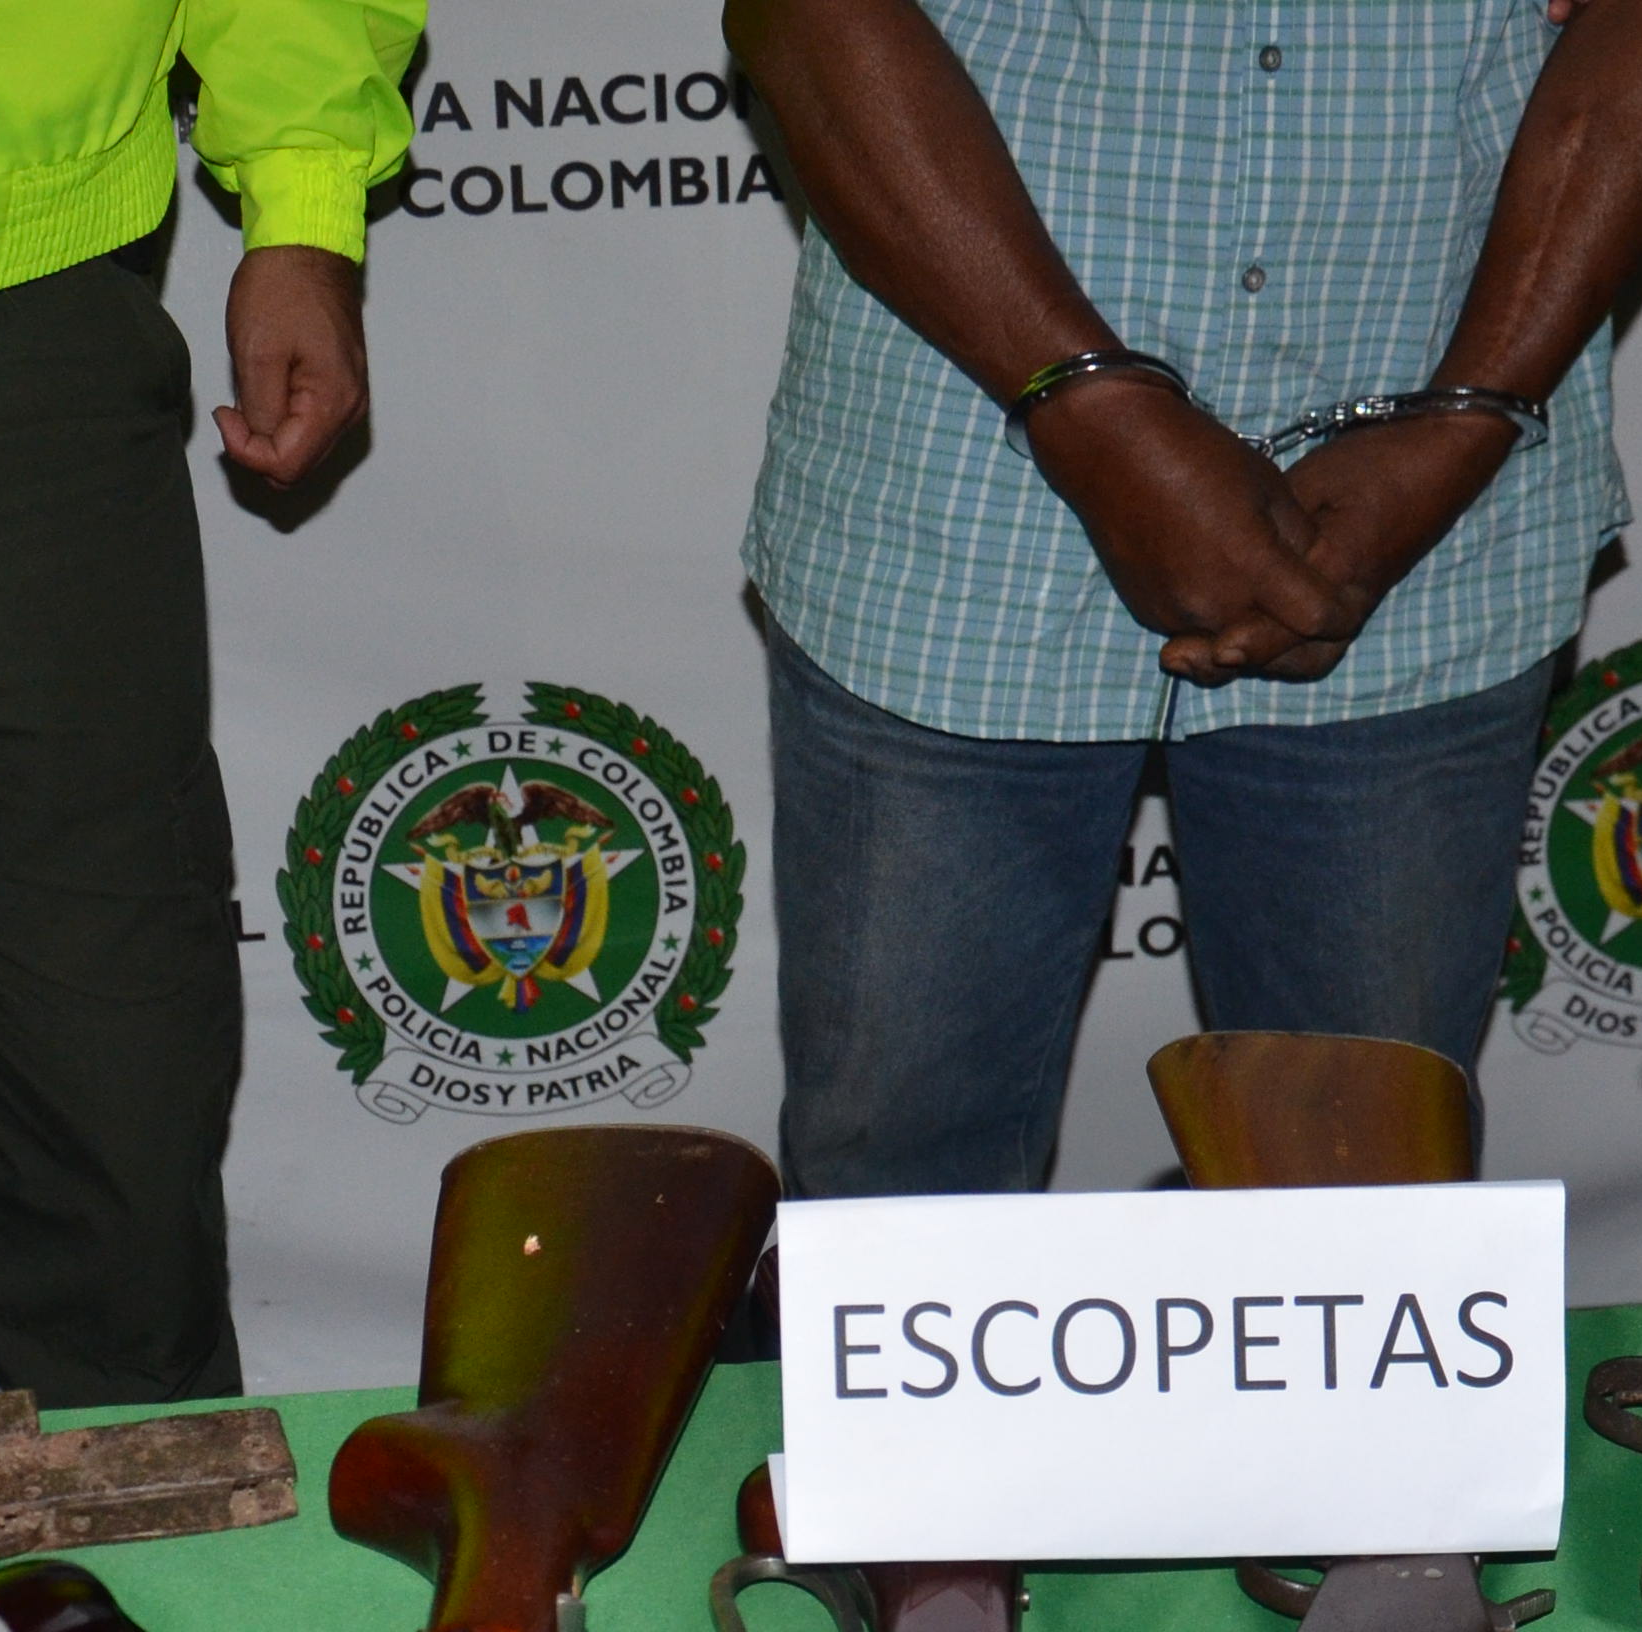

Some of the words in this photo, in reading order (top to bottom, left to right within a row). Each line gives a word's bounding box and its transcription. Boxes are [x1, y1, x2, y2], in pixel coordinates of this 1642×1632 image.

[401, 154, 785, 218] COLOMBIA
[488, 730, 537, 754] DE
[578, 748, 688, 914] COLOMBIA
[526, 957, 677, 1066] NACIONAL
[527, 1052, 642, 1106] PATRIA
[832, 1290, 1516, 1400] ESCOPETAS
